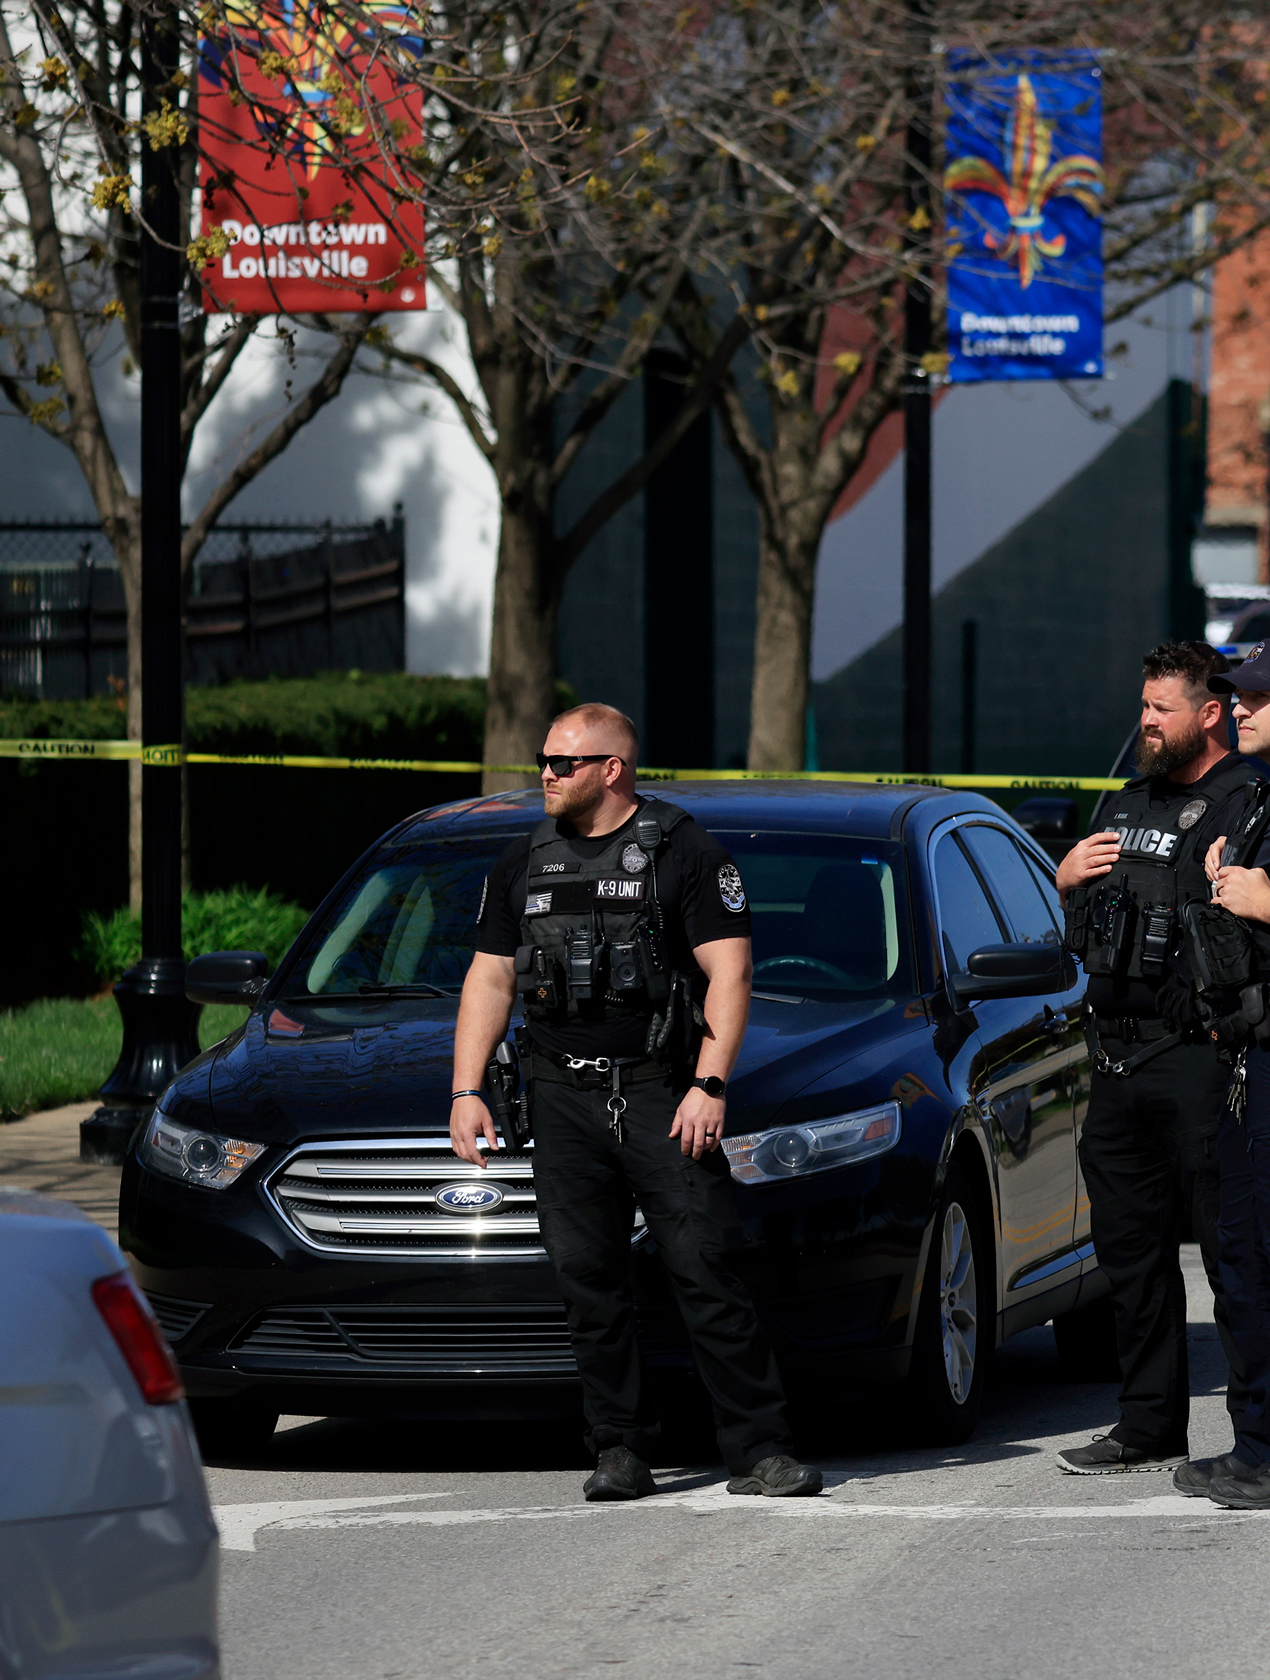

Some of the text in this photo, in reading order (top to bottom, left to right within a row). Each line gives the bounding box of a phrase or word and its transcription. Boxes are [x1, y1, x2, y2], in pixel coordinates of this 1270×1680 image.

[222, 219, 387, 246] Downtown
[222, 250, 369, 279] Louisville
[18, 743, 95, 756] CAUTION
[542, 863, 566, 873] 7206
[597, 880, 642, 897] K-9 UNIT
[451, 1188, 486, 1204] Ford
